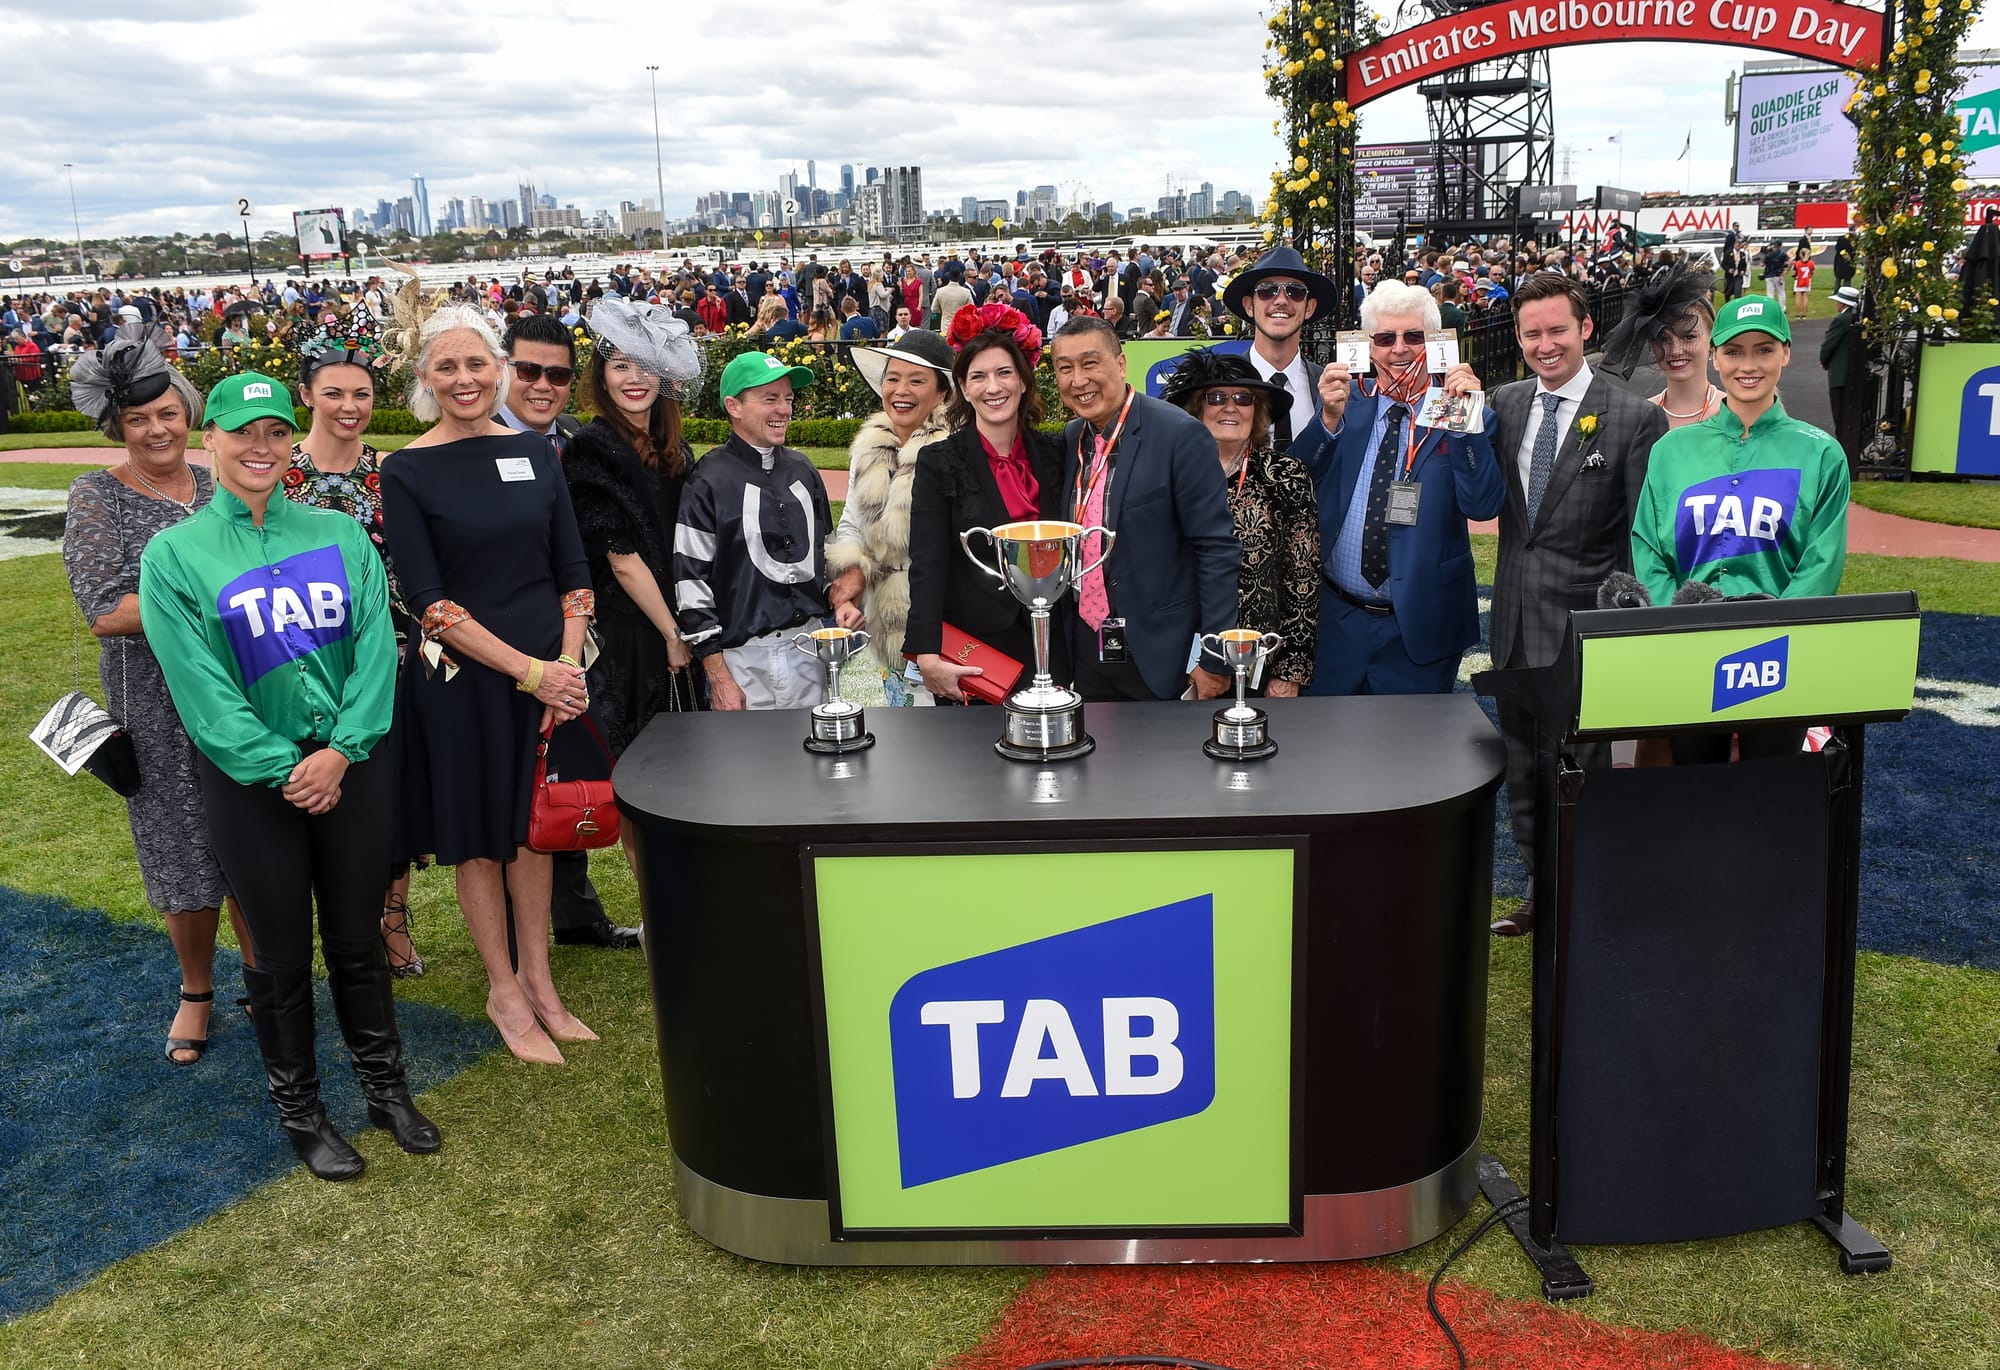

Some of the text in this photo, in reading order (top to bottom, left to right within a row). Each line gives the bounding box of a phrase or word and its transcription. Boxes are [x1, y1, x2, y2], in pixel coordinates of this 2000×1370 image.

[1358, 0, 1867, 88] Emirates Melbourne Cup Day
[1752, 79, 1839, 119] QUADDIE CASH
[1751, 101, 1822, 136] OUT IS HERE
[1954, 107, 2000, 136] TA
[1357, 148, 1405, 158] FLEMINGTON
[1383, 158, 1414, 166] PENZANCE
[238, 199, 250, 216] 2
[785, 200, 794, 214] 2
[1662, 207, 1730, 232] AAMI
[13, 260, 20, 270] 3
[1741, 305, 1761, 315] TAB
[1348, 348, 1358, 362] 2
[1440, 347, 1447, 361] 1
[247, 386, 270, 396] TAB
[1684, 494, 1783, 541] TAB
[229, 582, 346, 639] TAB
[1721, 660, 1781, 690] TAB
[920, 996, 1184, 1099] TAB
